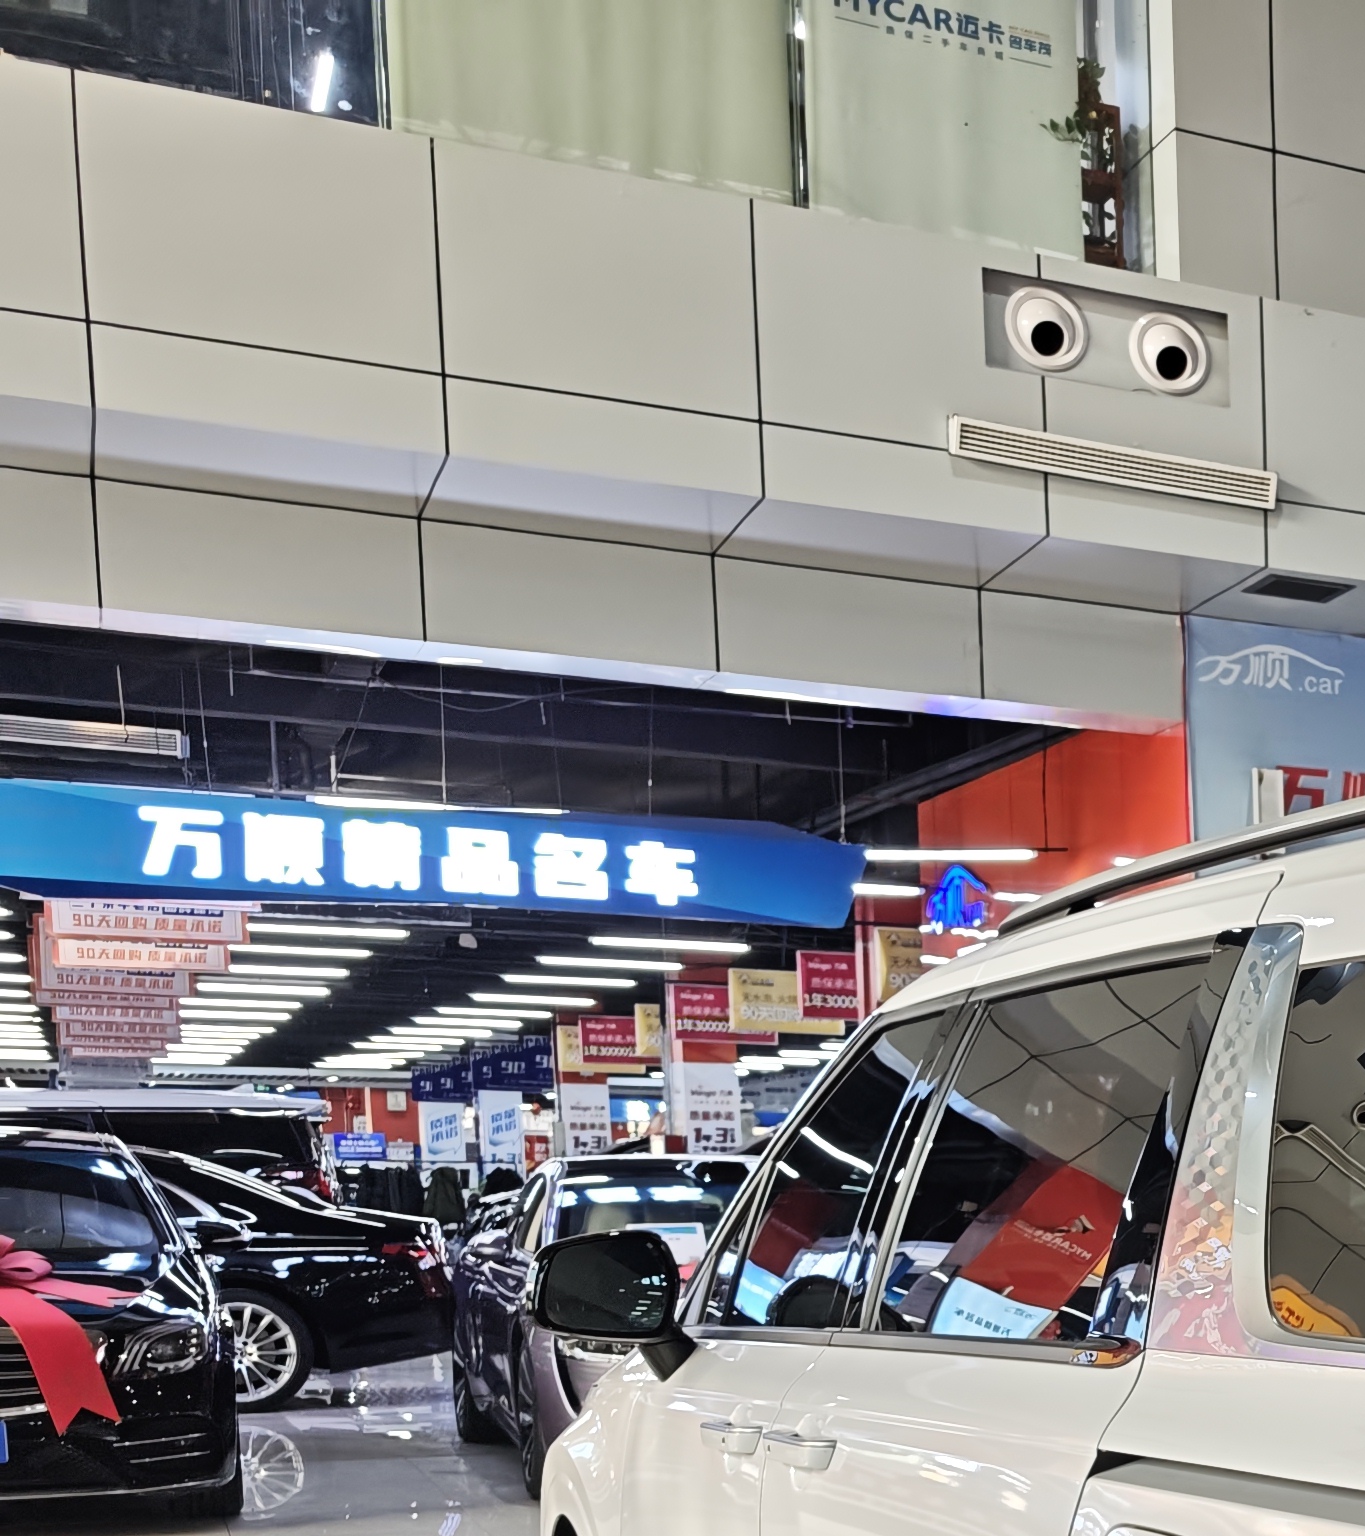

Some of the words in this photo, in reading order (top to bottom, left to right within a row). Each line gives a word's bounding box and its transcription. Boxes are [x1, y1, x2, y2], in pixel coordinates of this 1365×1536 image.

[72, 913, 147, 930] 90天回购
[154, 917, 222, 933] 质量承诺
